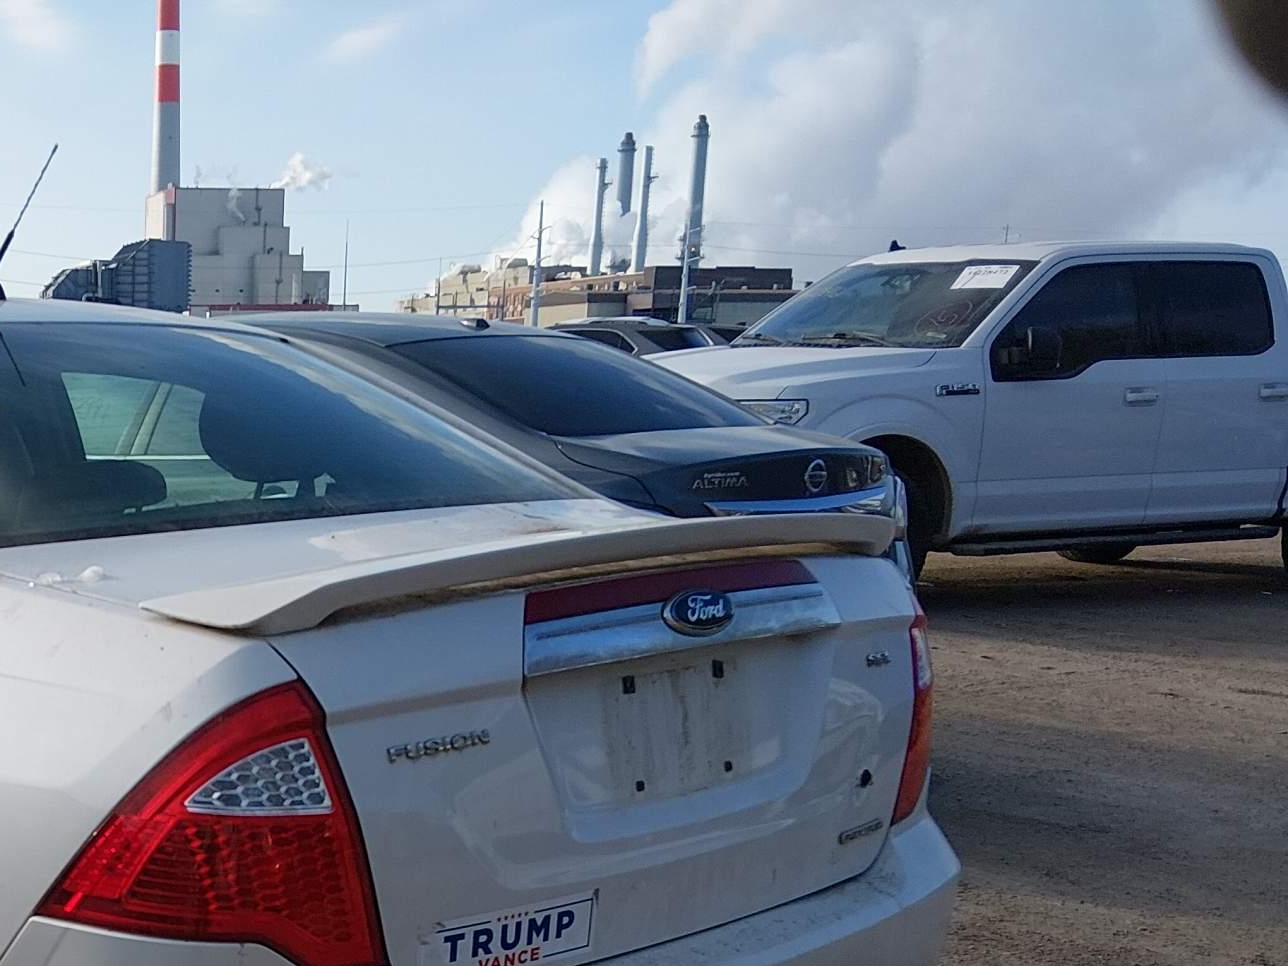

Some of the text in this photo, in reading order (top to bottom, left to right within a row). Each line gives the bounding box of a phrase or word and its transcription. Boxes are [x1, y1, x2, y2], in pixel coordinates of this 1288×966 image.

[692, 476, 749, 489] ALTIMA
[687, 594, 727, 622] Ford
[386, 728, 491, 764] FUSION
[442, 909, 575, 963] TRUMP
